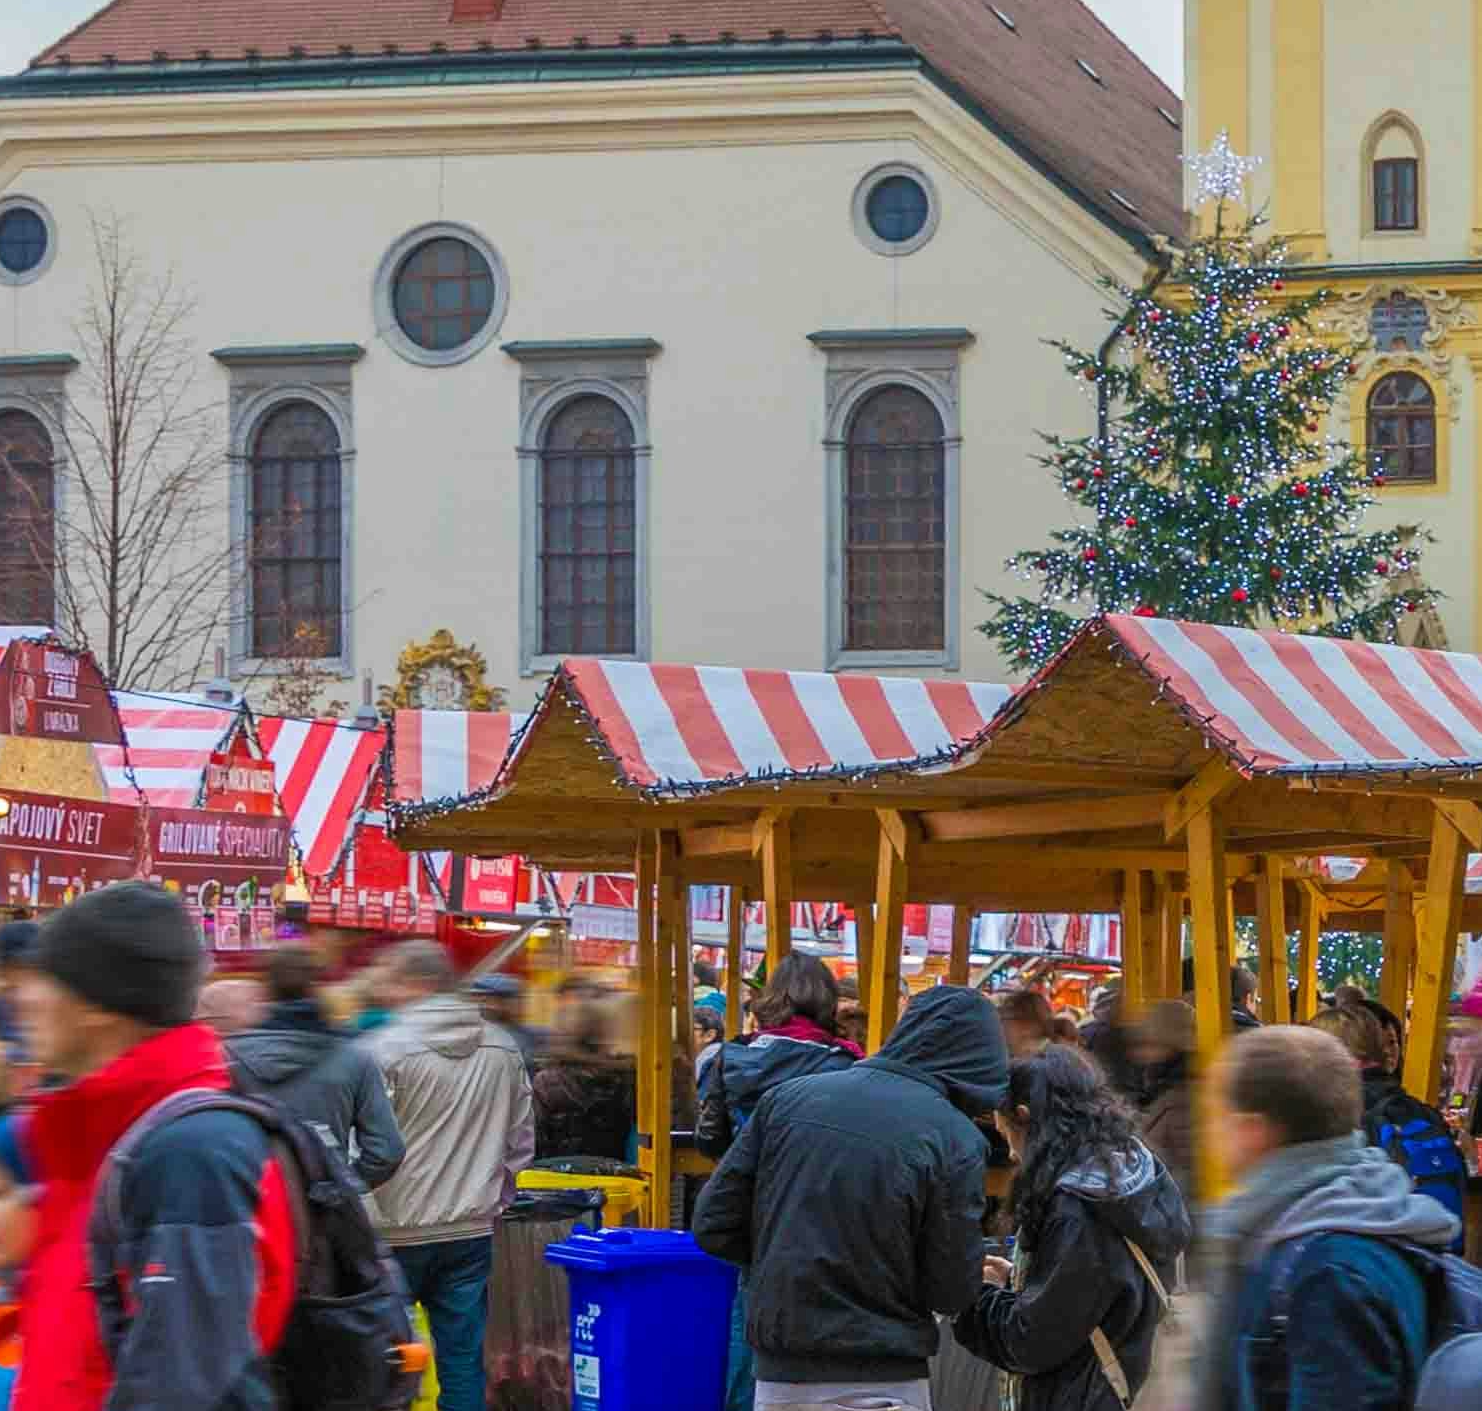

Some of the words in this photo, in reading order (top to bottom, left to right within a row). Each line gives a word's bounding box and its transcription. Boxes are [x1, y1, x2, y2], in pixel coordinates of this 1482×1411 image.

[67, 809, 105, 845] SVET
[159, 820, 221, 856] GRILOVANÉ
[222, 821, 286, 858] ŠPECIALITY
